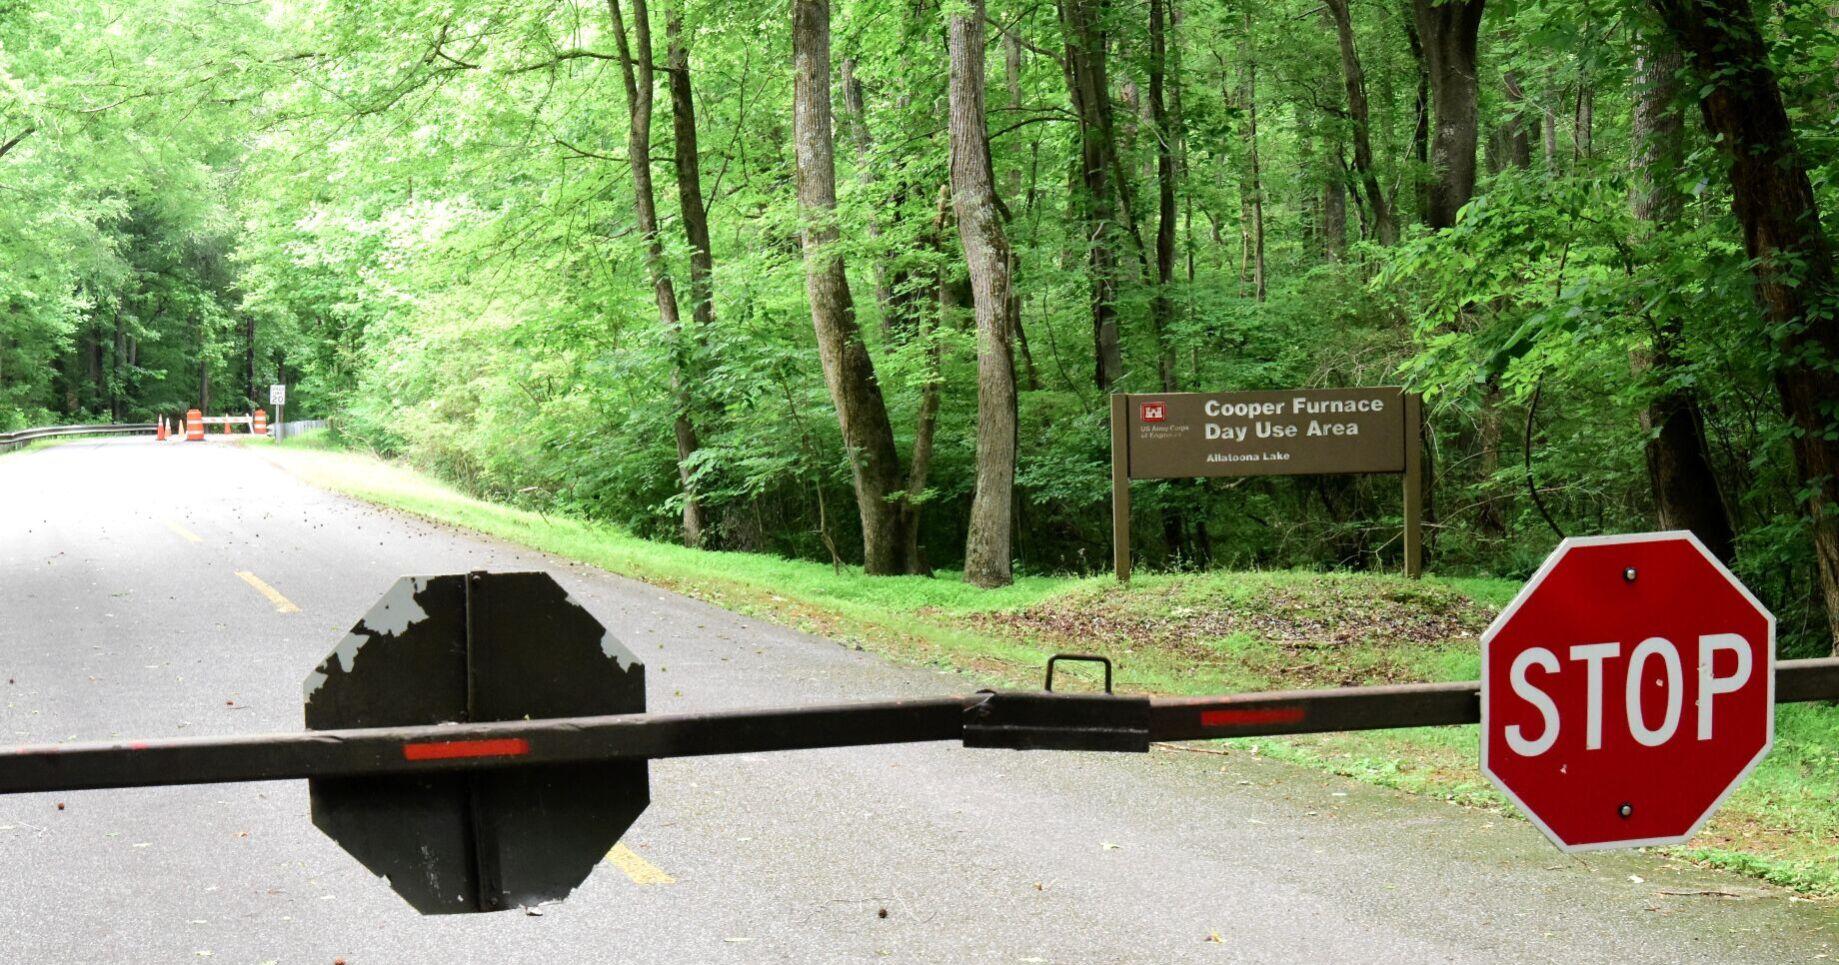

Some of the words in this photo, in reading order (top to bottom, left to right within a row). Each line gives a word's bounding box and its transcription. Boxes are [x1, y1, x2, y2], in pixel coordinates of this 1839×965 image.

[272, 395, 283, 403] 20
[1204, 400, 1286, 419] Cooper
[1292, 397, 1384, 414] Furnace
[1205, 423, 1247, 441] Day
[1255, 421, 1298, 438] Use
[1306, 420, 1359, 436] Area
[1206, 453, 1260, 463] Allatoona
[1263, 451, 1290, 461] Lake
[1505, 633, 1753, 757] STOP
